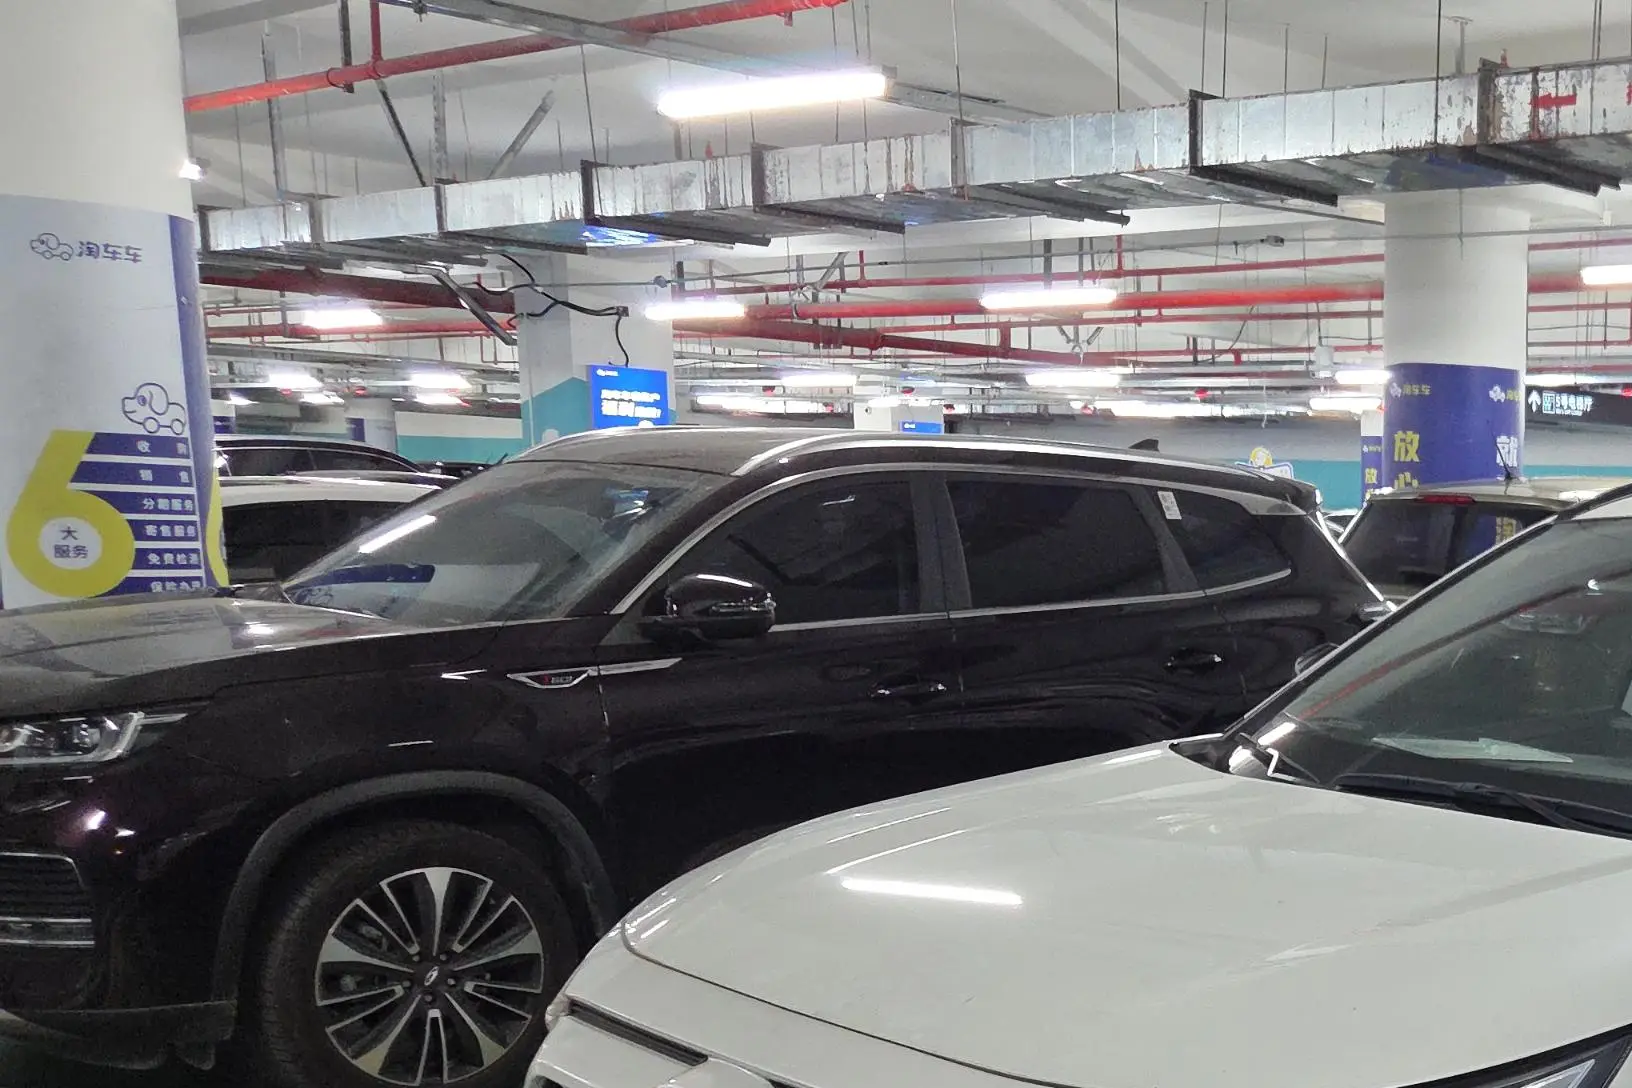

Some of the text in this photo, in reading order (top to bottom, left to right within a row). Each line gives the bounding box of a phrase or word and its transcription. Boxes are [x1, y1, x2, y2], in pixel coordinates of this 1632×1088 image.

[76, 240, 142, 263] 淘车车
[60, 525, 79, 541] 大
[54, 543, 88, 560] 服务
